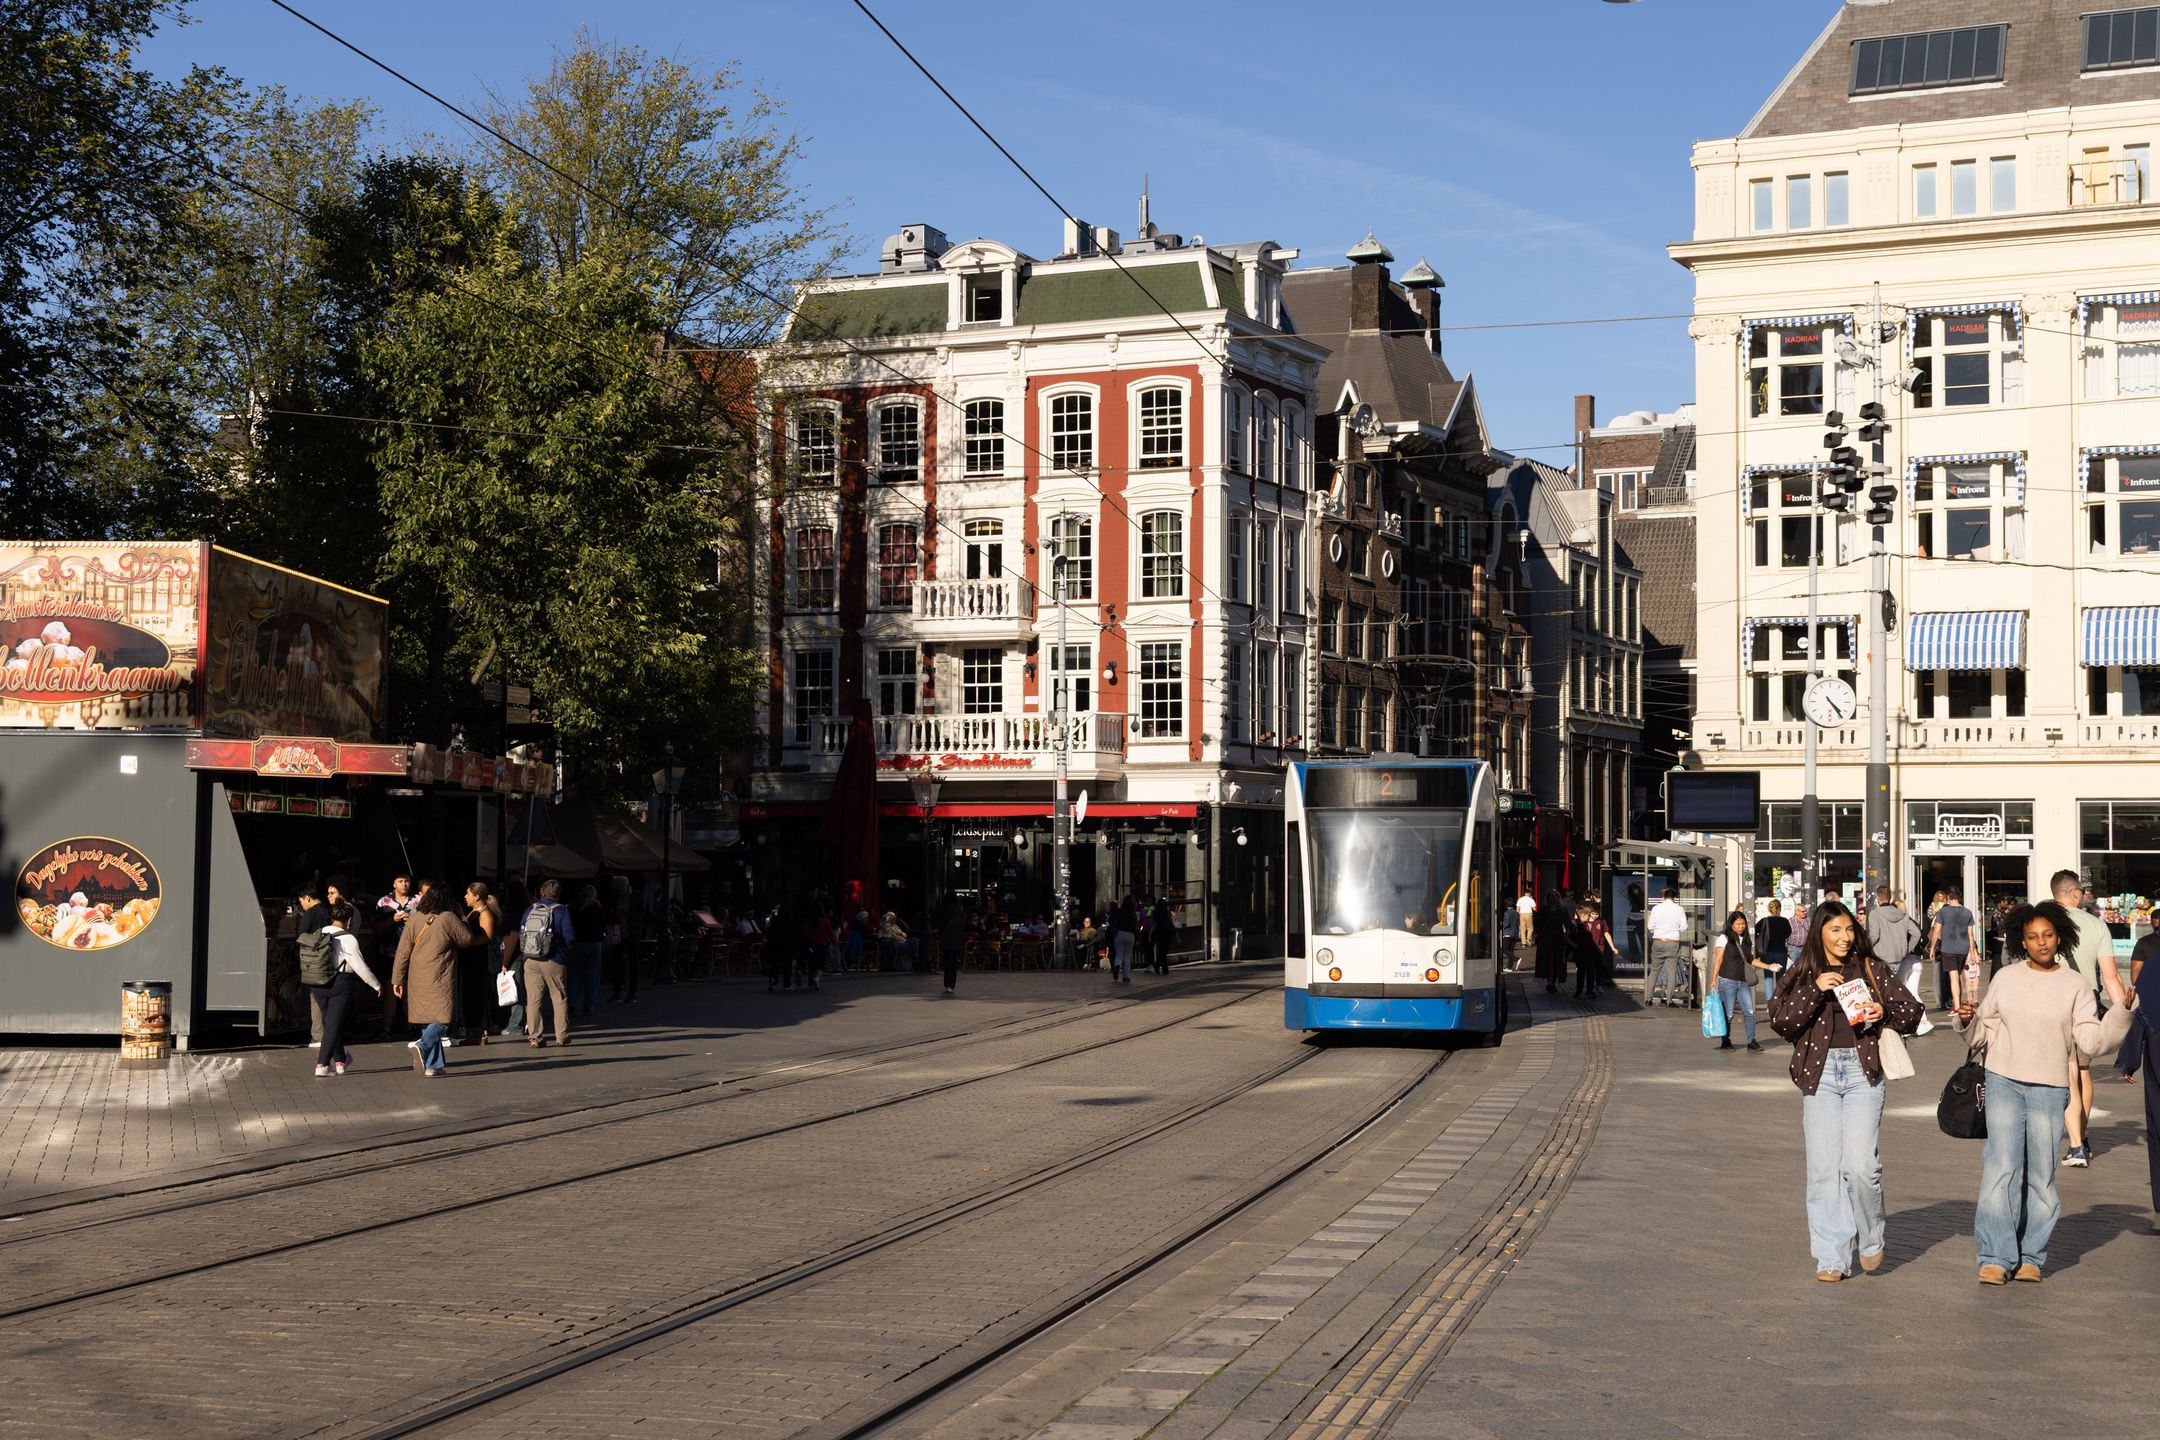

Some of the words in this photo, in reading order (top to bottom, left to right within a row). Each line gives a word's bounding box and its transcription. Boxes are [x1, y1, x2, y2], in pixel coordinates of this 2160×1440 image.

[1949, 323, 1985, 333] HADRIAN
[1785, 335, 1819, 344] HADRIAN
[2130, 478, 2160, 486] Infront
[1957, 486, 1986, 494] Infront
[1791, 494, 1819, 502] Infro
[0, 591, 124, 623] Amsterdamse
[934, 753, 1033, 769] Steakhouse
[1380, 772, 1393, 797] 2
[951, 823, 1003, 841] Leidseplein
[1943, 818, 1996, 834] Normal
[971, 850, 979, 858] 2
[80, 849, 103, 861] vers
[98, 852, 148, 891] gebakken
